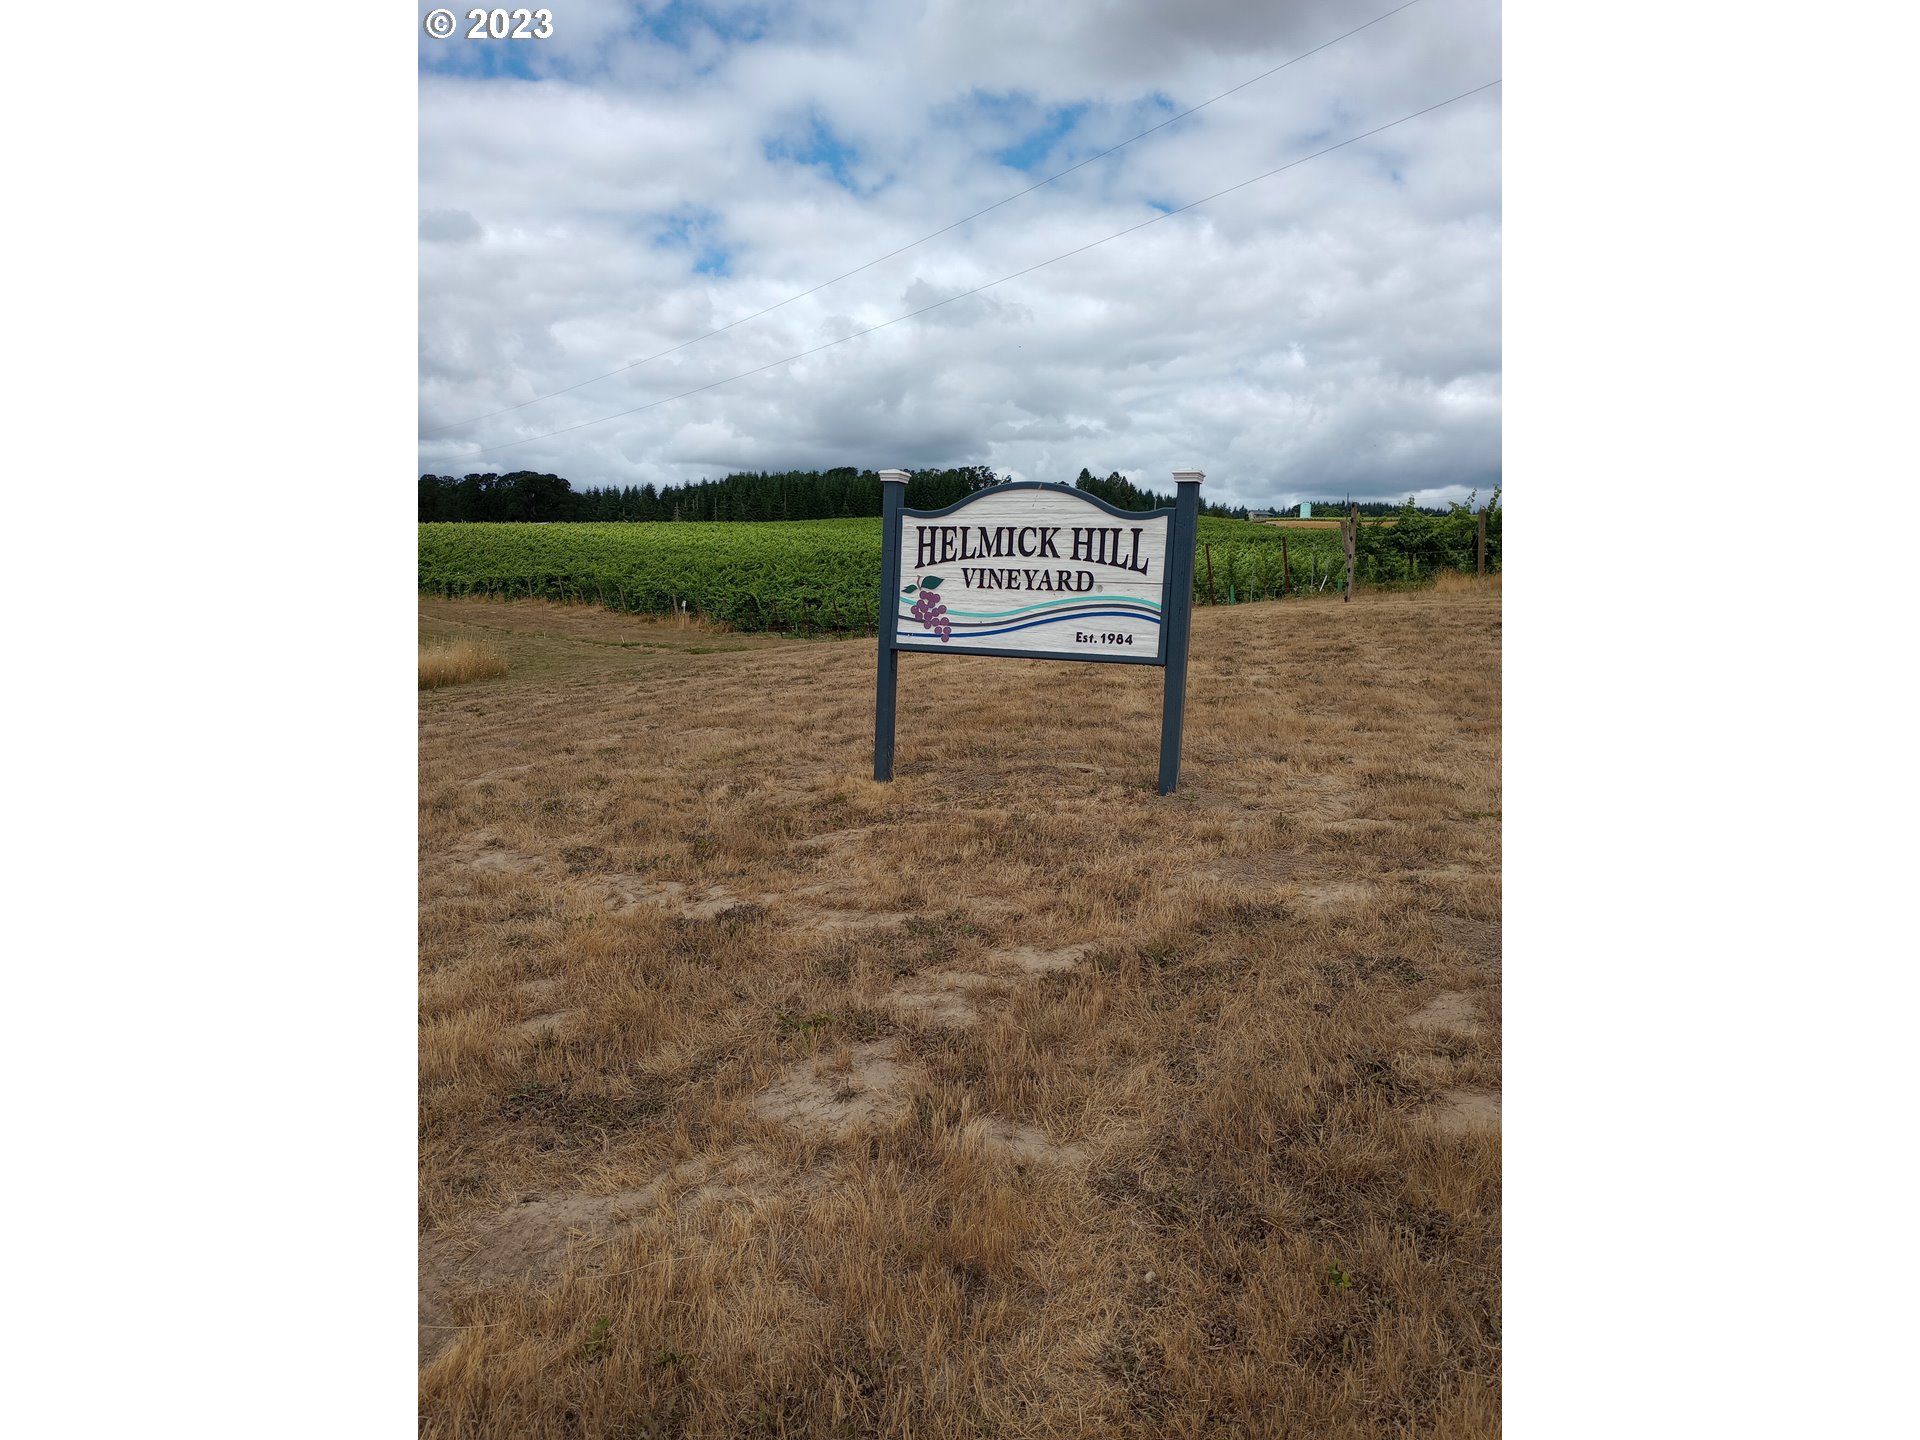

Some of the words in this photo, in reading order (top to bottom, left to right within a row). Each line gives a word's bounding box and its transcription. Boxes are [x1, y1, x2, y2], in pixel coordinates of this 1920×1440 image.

[914, 525, 1062, 569] HELMICK
[1069, 527, 1150, 576] HILL
[960, 567, 1095, 592] VINEYARD
[1075, 632, 1098, 644] Est.
[1100, 632, 1134, 646] 1984
